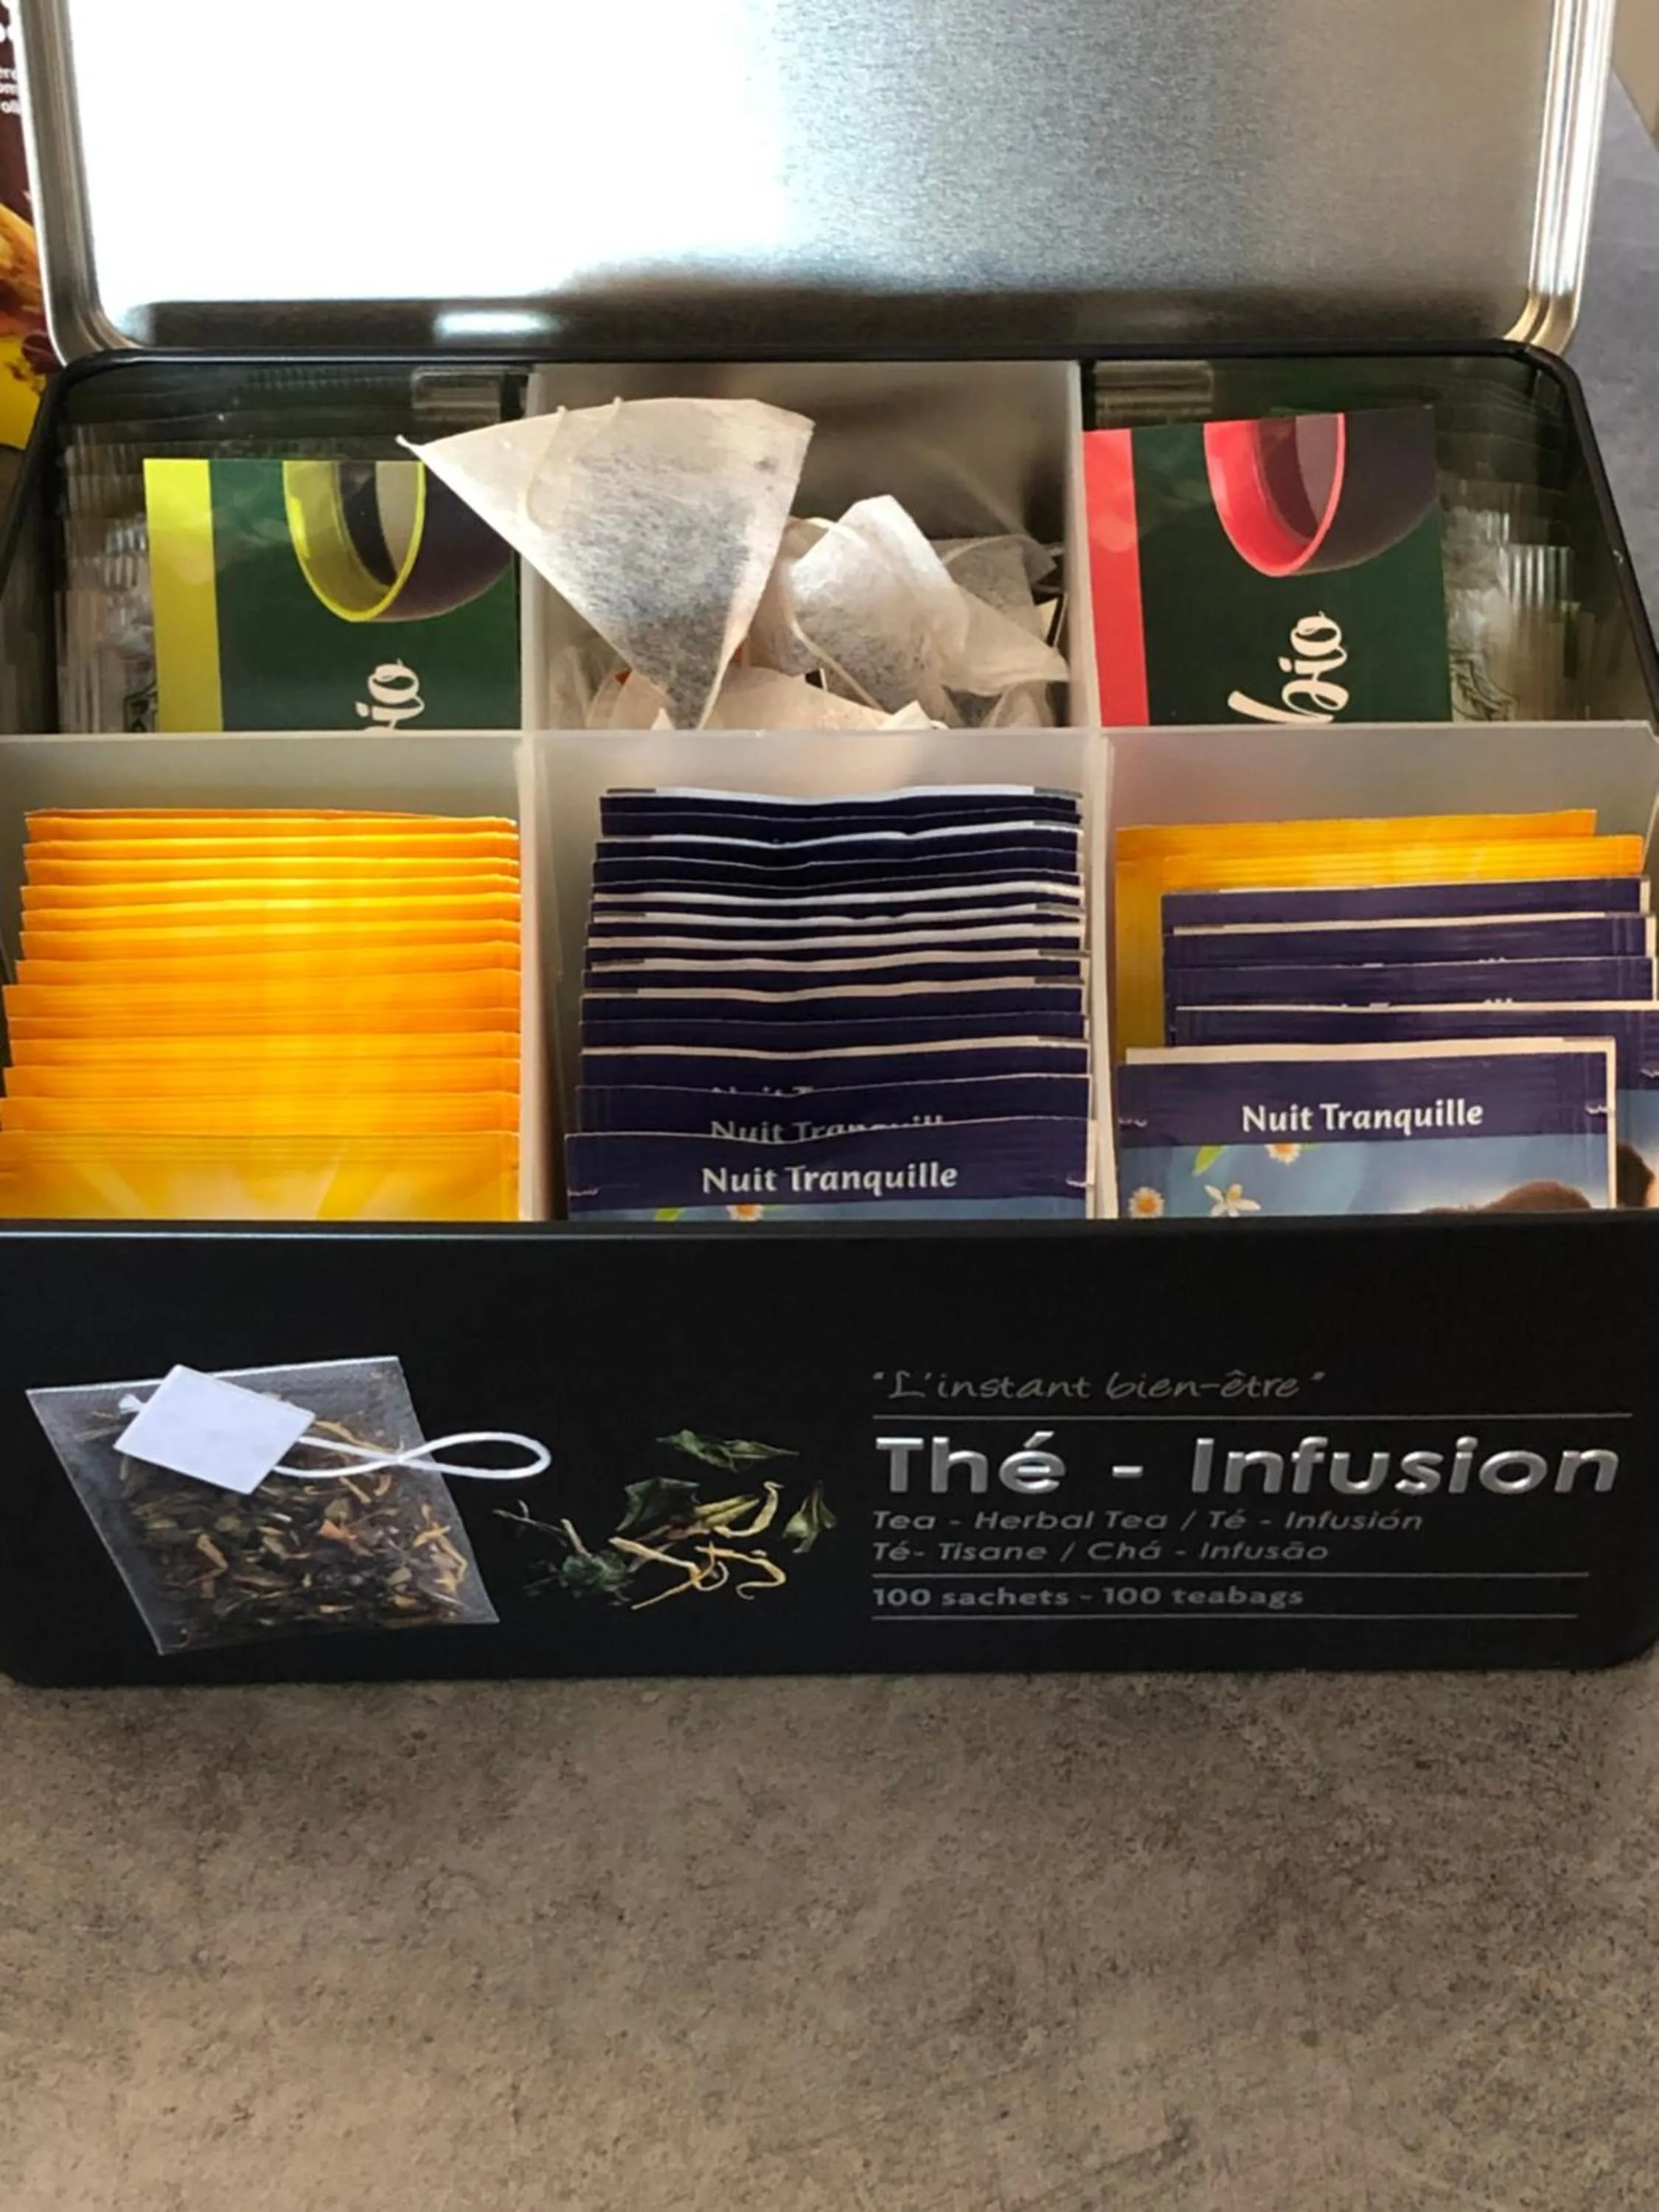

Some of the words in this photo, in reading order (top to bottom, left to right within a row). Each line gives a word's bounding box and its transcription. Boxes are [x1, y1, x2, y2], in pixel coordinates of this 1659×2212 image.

[1228, 611, 1349, 723] bio
[355, 658, 425, 730] io
[1242, 1105, 1314, 1133] Nuit
[1319, 1098, 1484, 1137] Tranquille
[702, 1166, 778, 1193] Nuit
[784, 1161, 959, 1197] Tranquille
[875, 1430, 1066, 1494] Thé
[1112, 1465, 1144, 1478] -
[1192, 1436, 1619, 1495] Infusion
[873, 1510, 936, 1530] Tea
[974, 1510, 1094, 1530] Herbal
[1105, 1510, 1168, 1530] Tea
[1180, 1509, 1197, 1531] /
[1208, 1508, 1247, 1529] Té
[1285, 1508, 1423, 1531] Infusión
[939, 1543, 1048, 1561] Tisane
[1060, 1541, 1077, 1564] /
[1087, 1540, 1162, 1561] Chá
[1199, 1540, 1329, 1561] Infusão
[873, 1587, 931, 1606] 100
[942, 1587, 1069, 1606] sachets
[1103, 1587, 1161, 1605] 100
[1172, 1585, 1304, 1610] teabags
